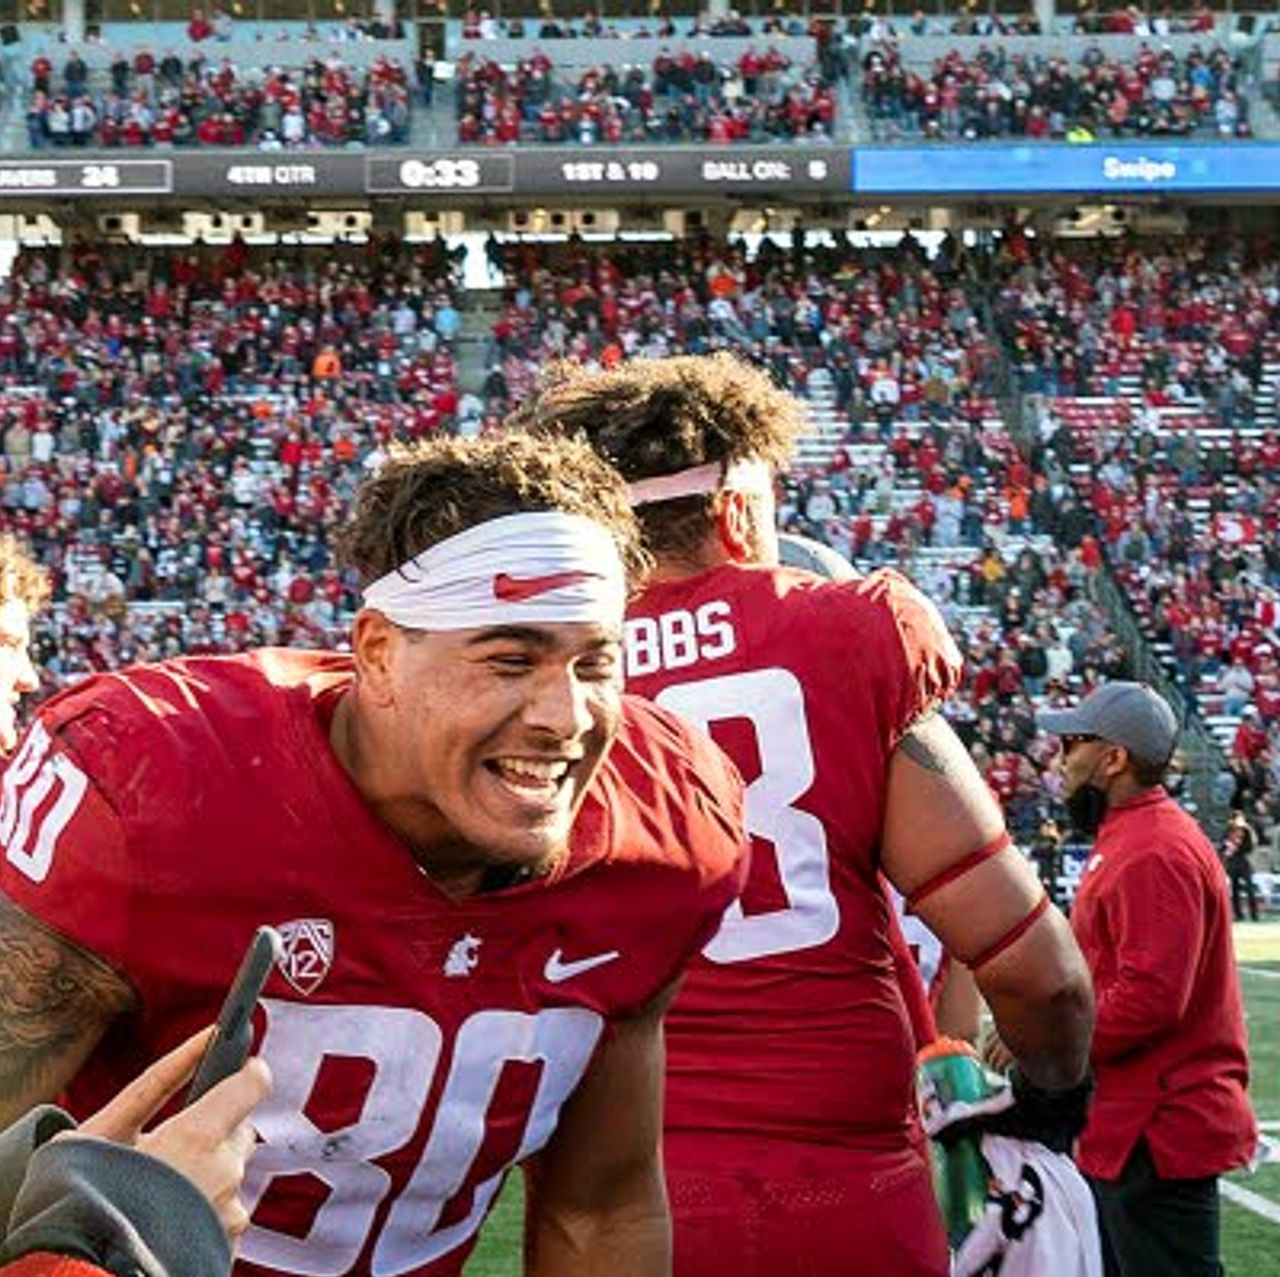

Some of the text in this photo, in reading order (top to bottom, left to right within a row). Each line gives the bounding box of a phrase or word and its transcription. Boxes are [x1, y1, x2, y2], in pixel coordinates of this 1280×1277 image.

[275, 166, 315, 184] QTR
[400, 159, 480, 187] 0:33
[1104, 156, 1177, 181] Swipe
